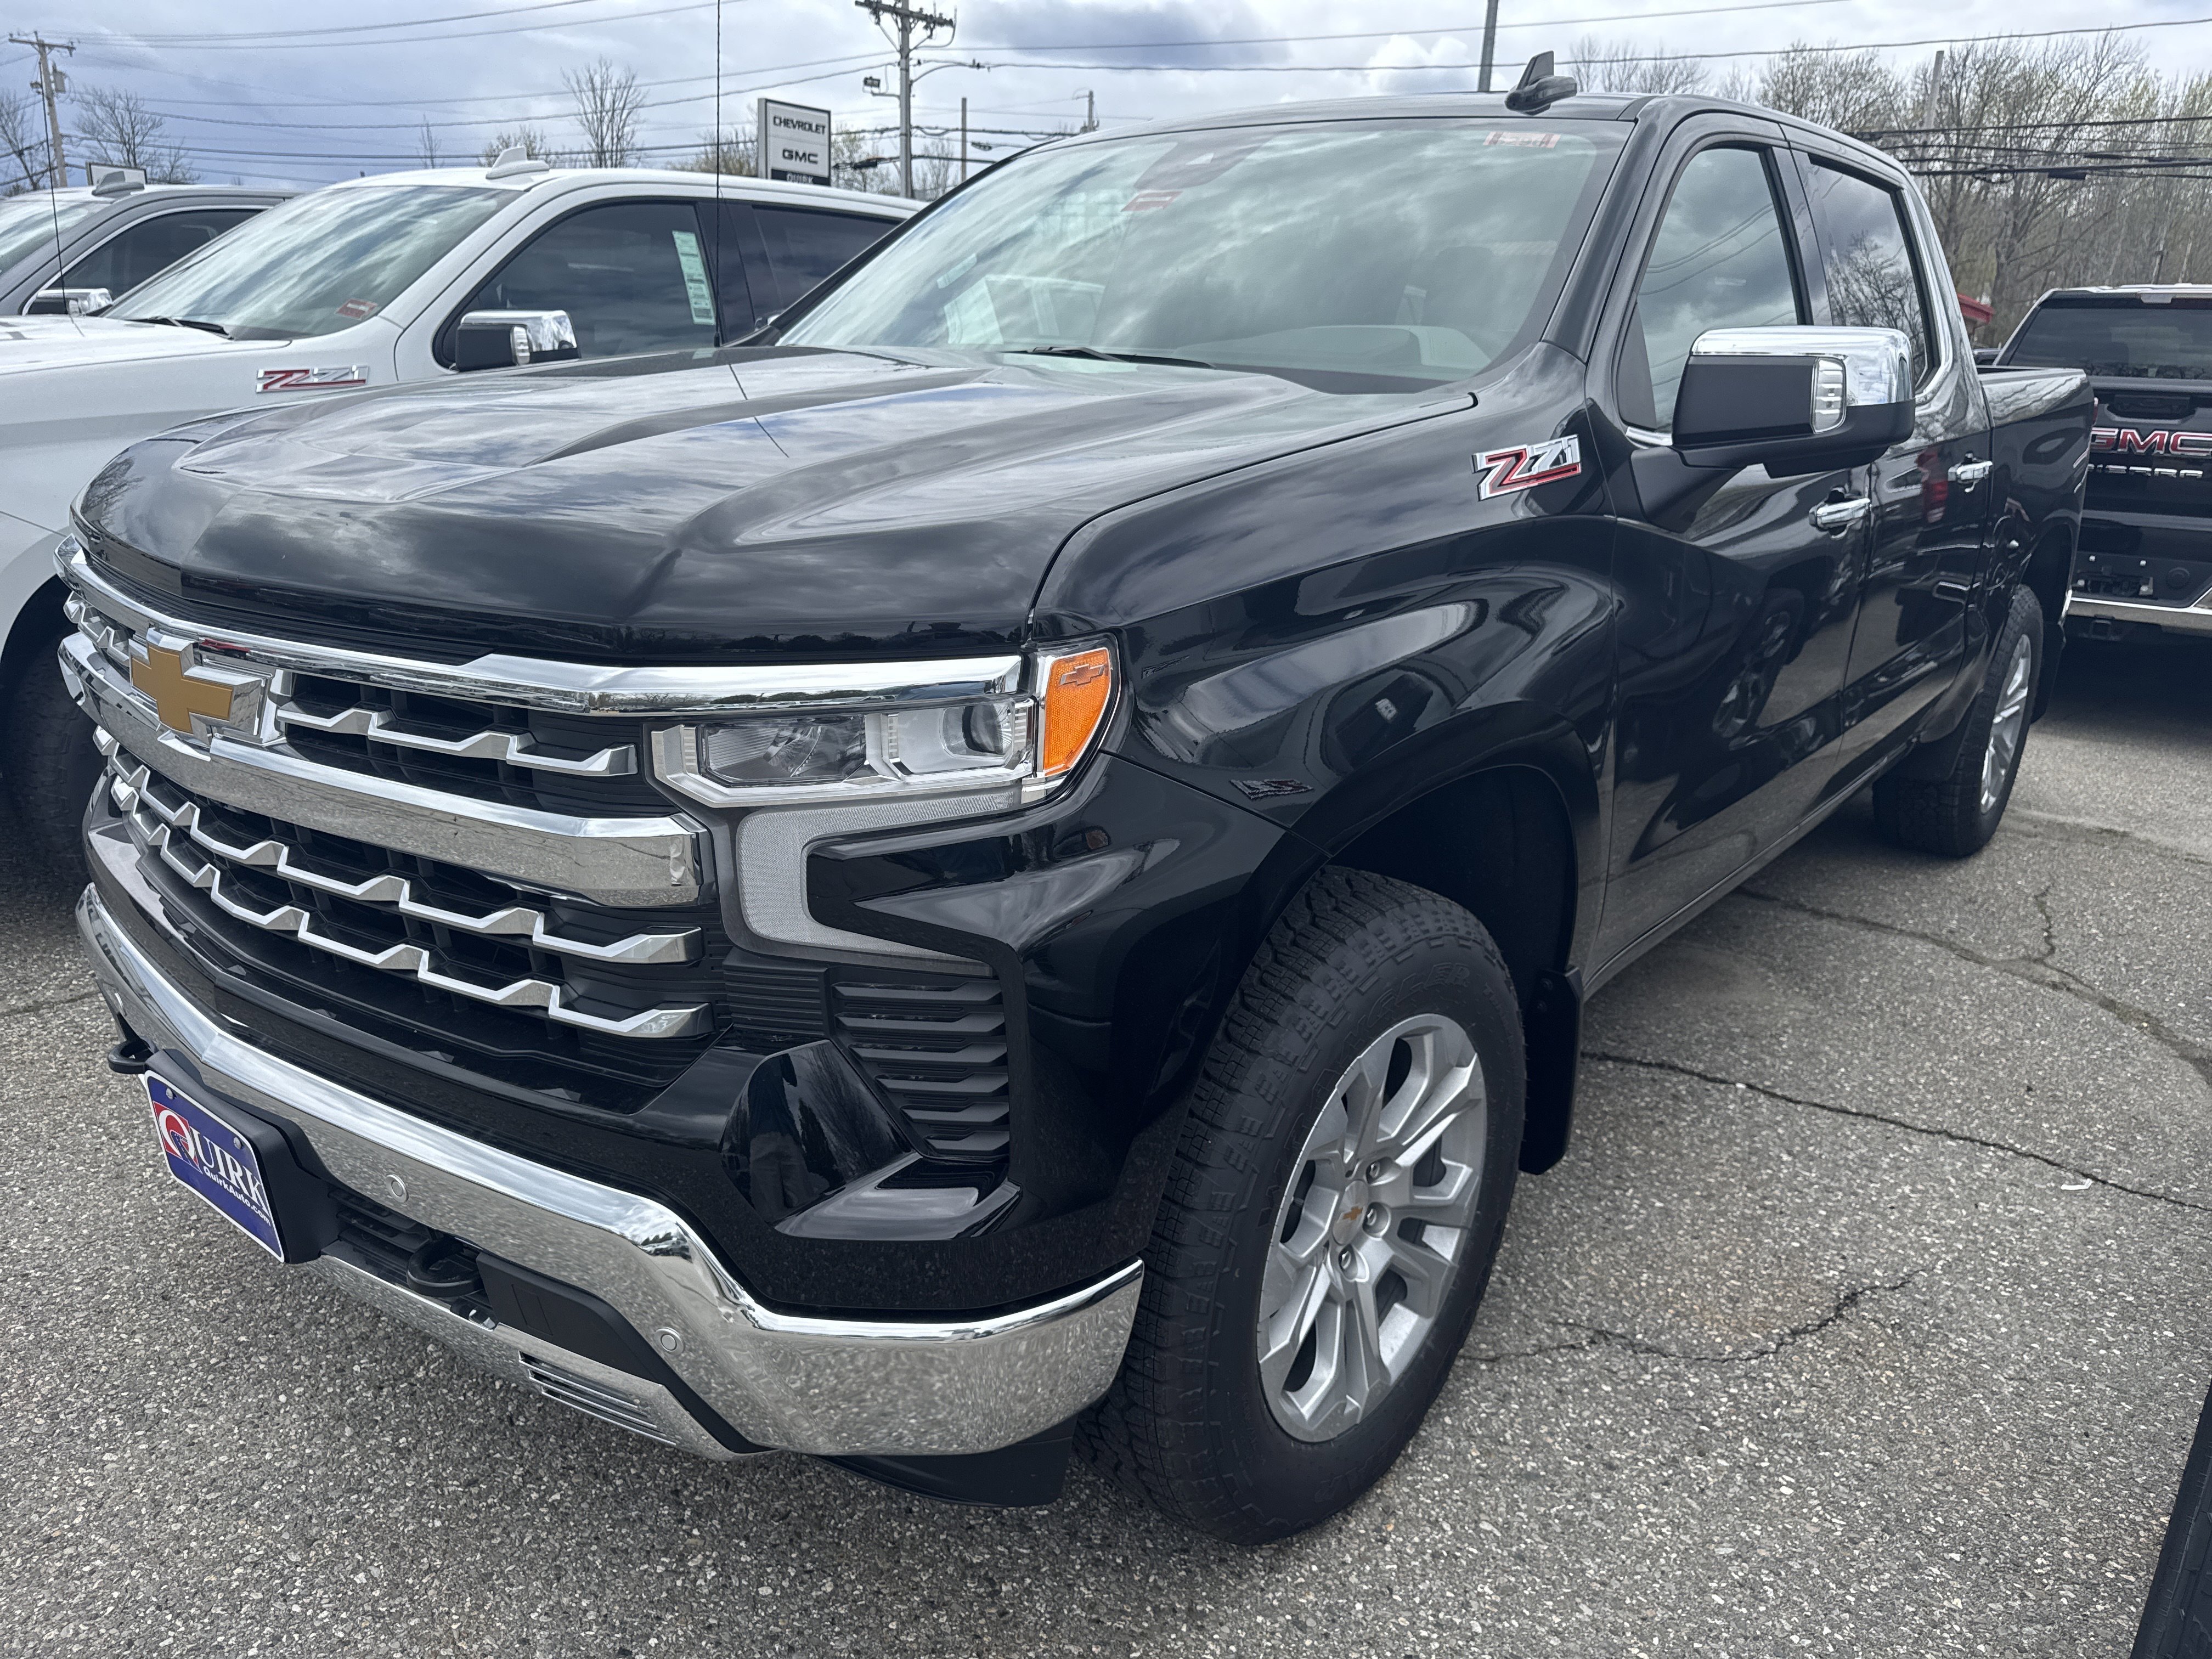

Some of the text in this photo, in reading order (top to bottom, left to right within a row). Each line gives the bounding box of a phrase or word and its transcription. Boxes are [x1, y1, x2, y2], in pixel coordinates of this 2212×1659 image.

[773, 116, 826, 134] CHEVROLET
[783, 149, 818, 164] GMC
[256, 365, 369, 393] Z71
[1471, 434, 1581, 501] Z71
[158, 1109, 270, 1217] QUIRK
[203, 1165, 271, 1227] QuirkAuto.com
